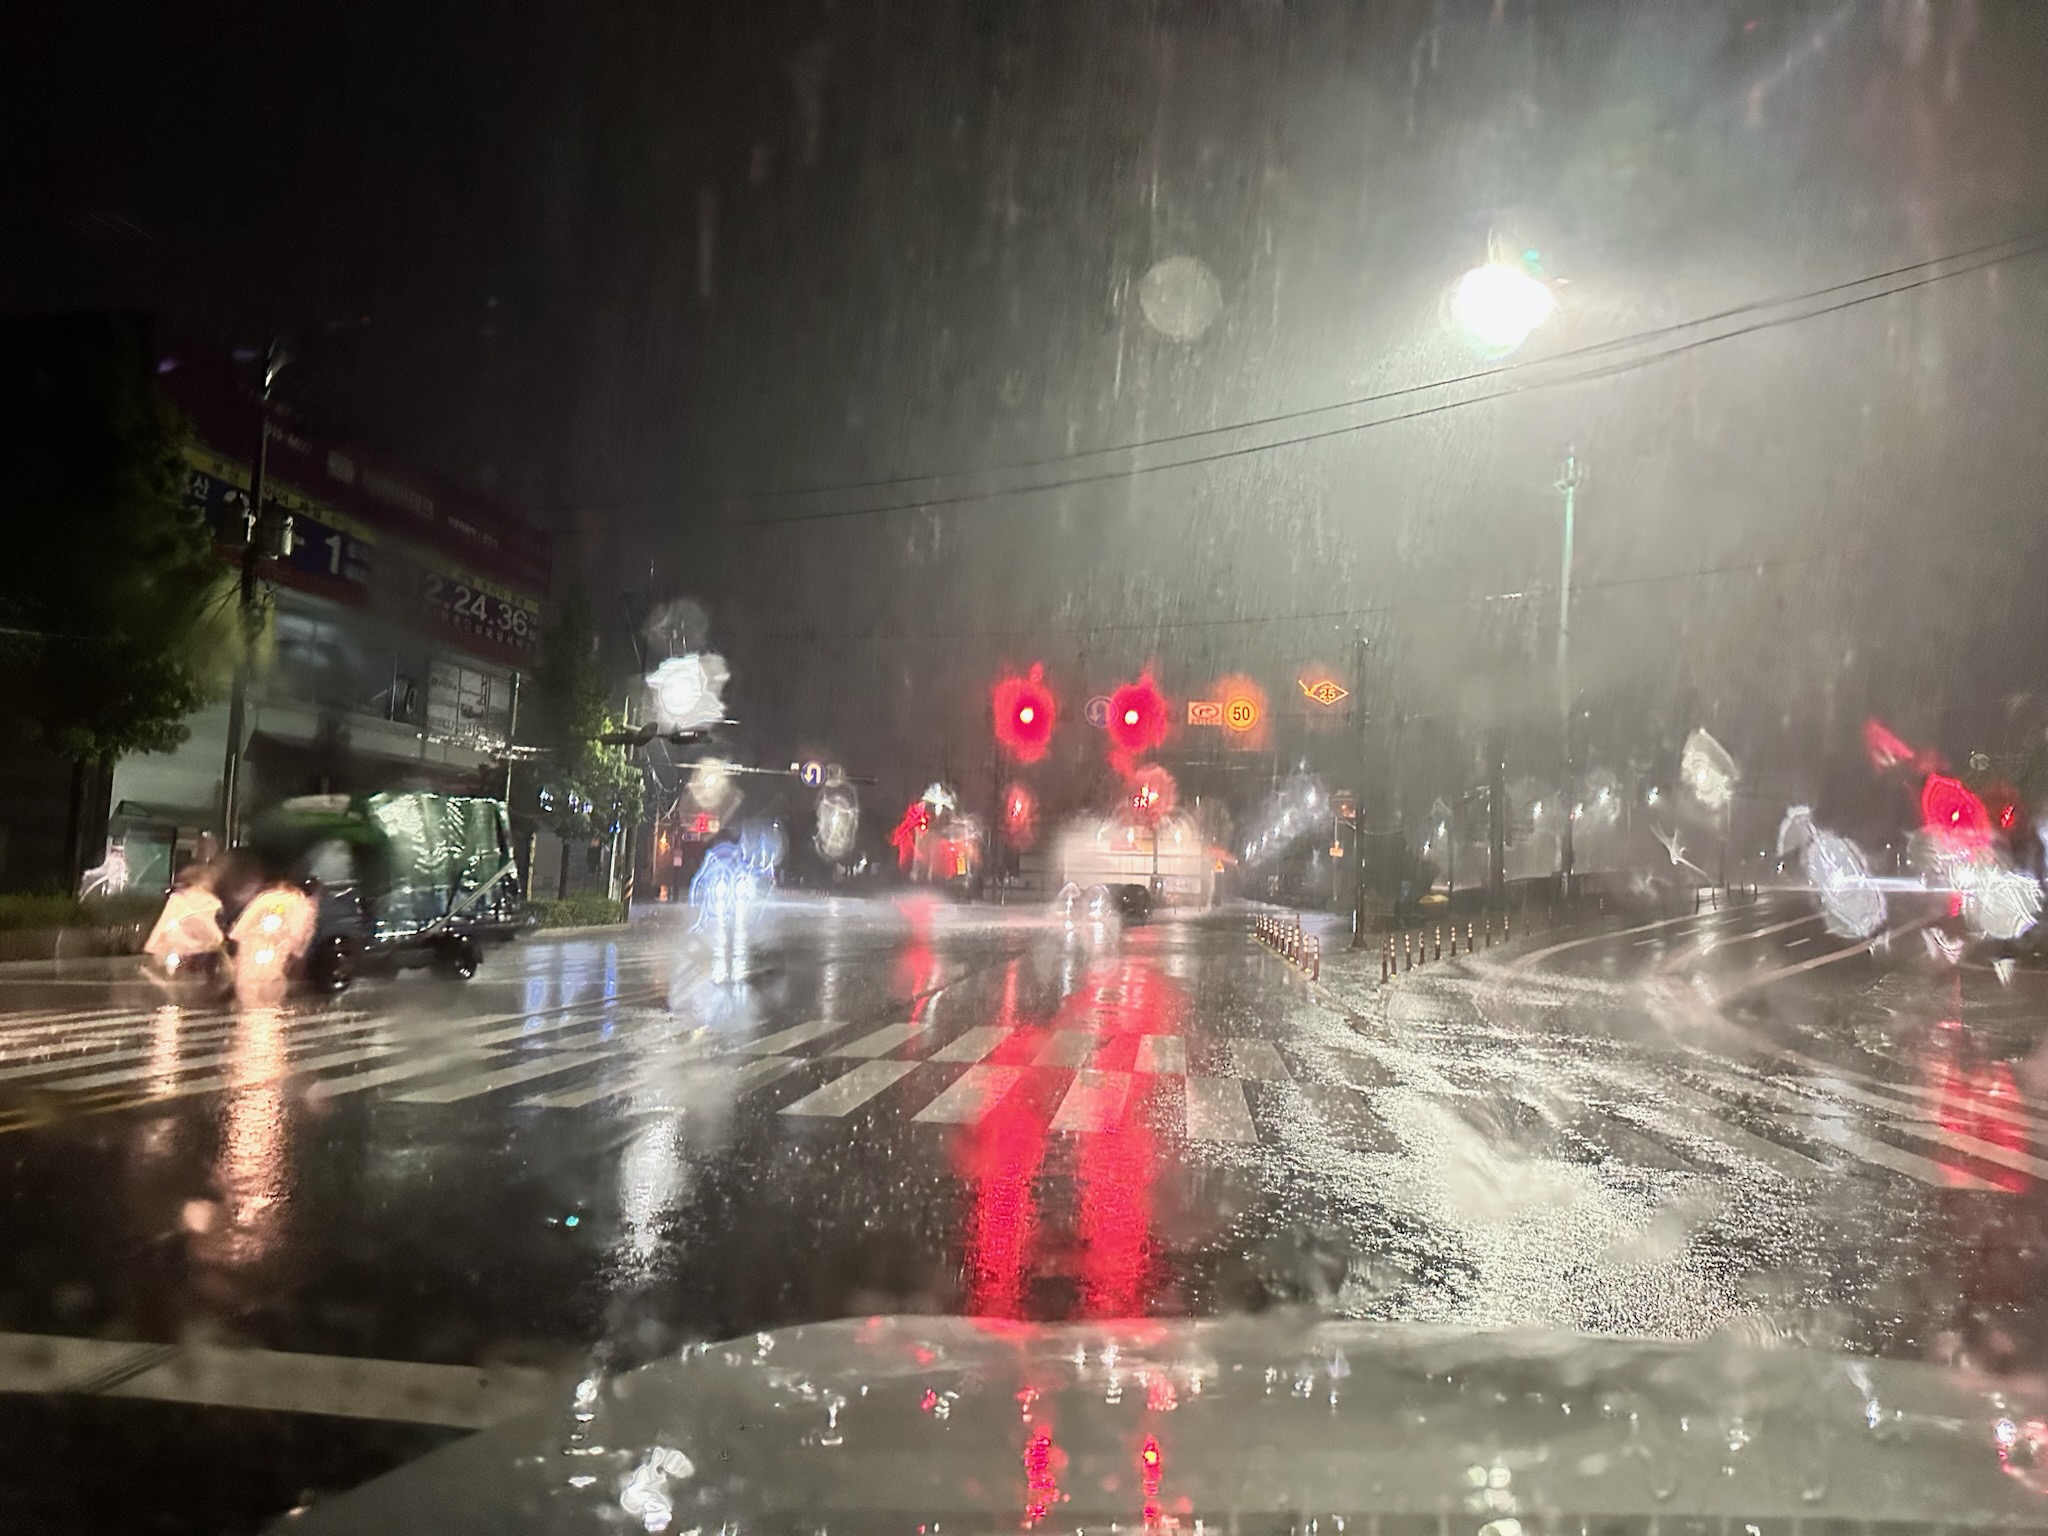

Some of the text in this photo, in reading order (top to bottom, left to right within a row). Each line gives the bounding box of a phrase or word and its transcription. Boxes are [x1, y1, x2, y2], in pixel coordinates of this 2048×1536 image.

[1319, 689, 1337, 700] 25
[1233, 706, 1250, 721] 50
[1133, 796, 1148, 808] SK
